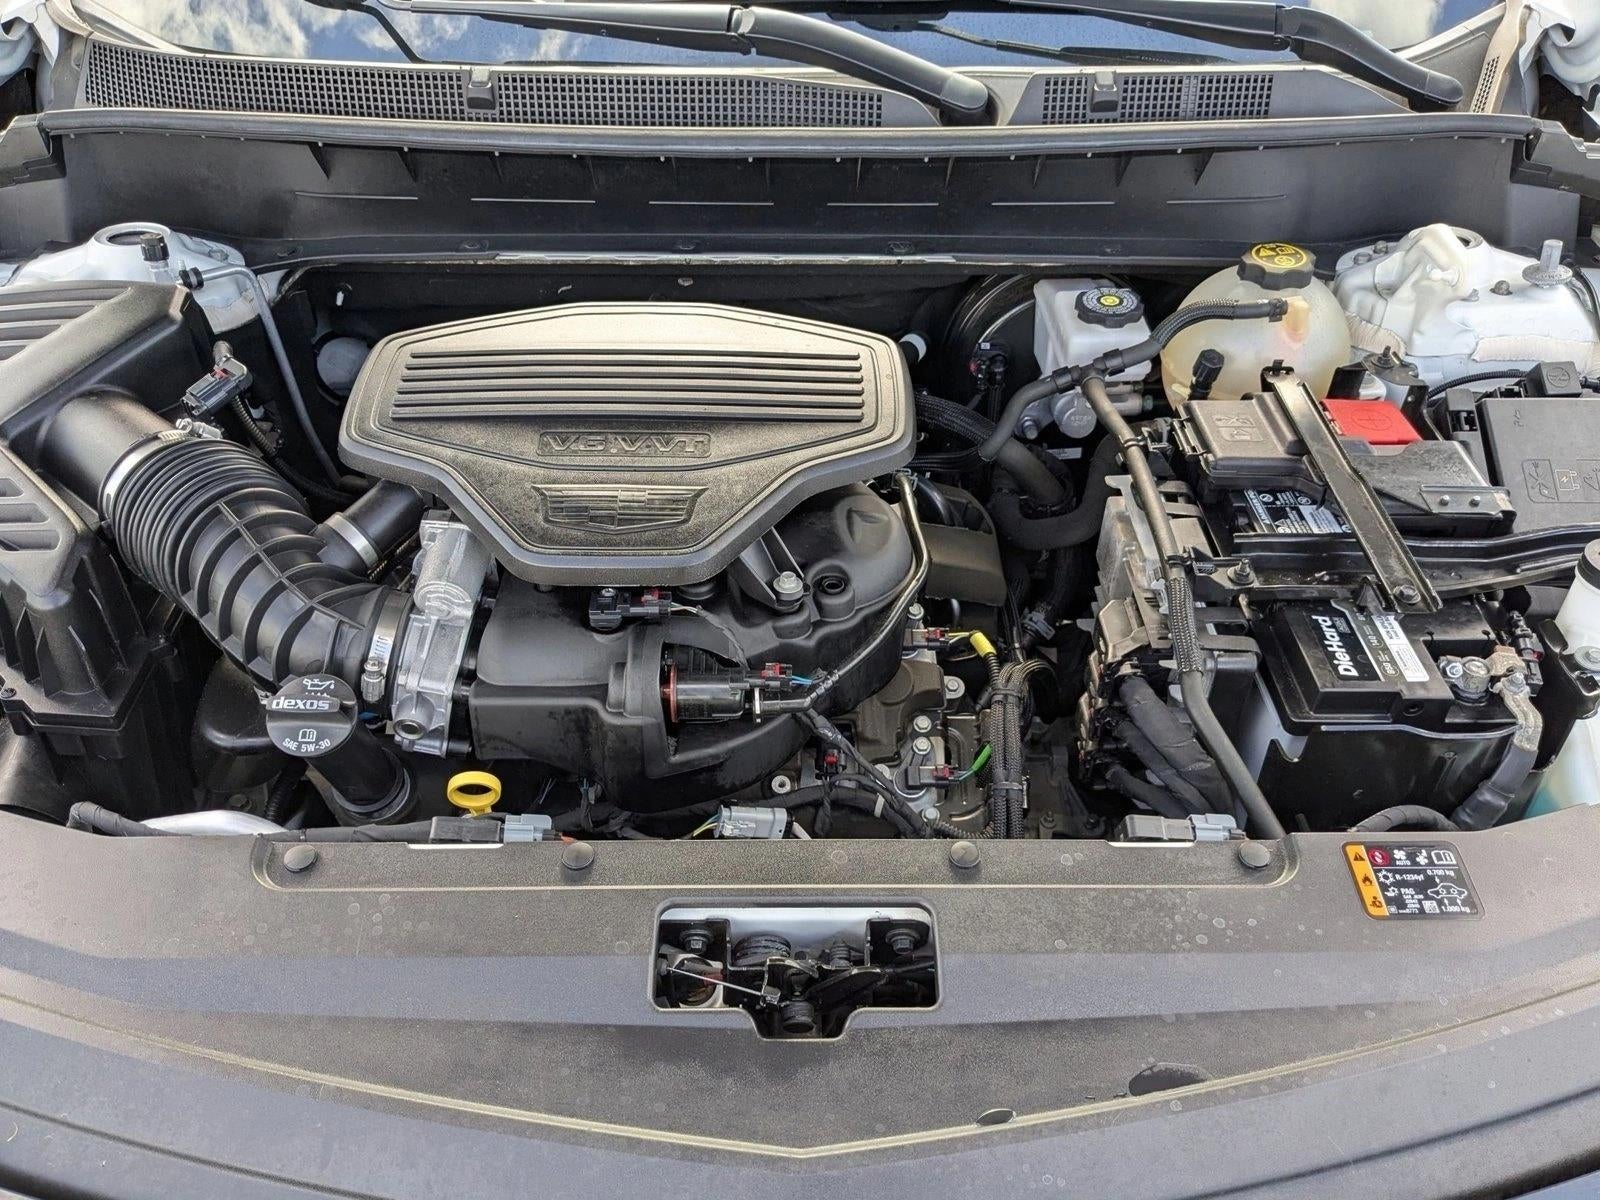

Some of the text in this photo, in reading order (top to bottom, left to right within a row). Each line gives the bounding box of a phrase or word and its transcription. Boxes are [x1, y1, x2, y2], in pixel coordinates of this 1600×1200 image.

[1311, 615, 1359, 677] DieHard
[271, 696, 333, 710] dexos
[282, 738, 331, 752] SAE 5W-30
[1395, 873, 1424, 881] R-1234yf
[1445, 869, 1455, 877] kg
